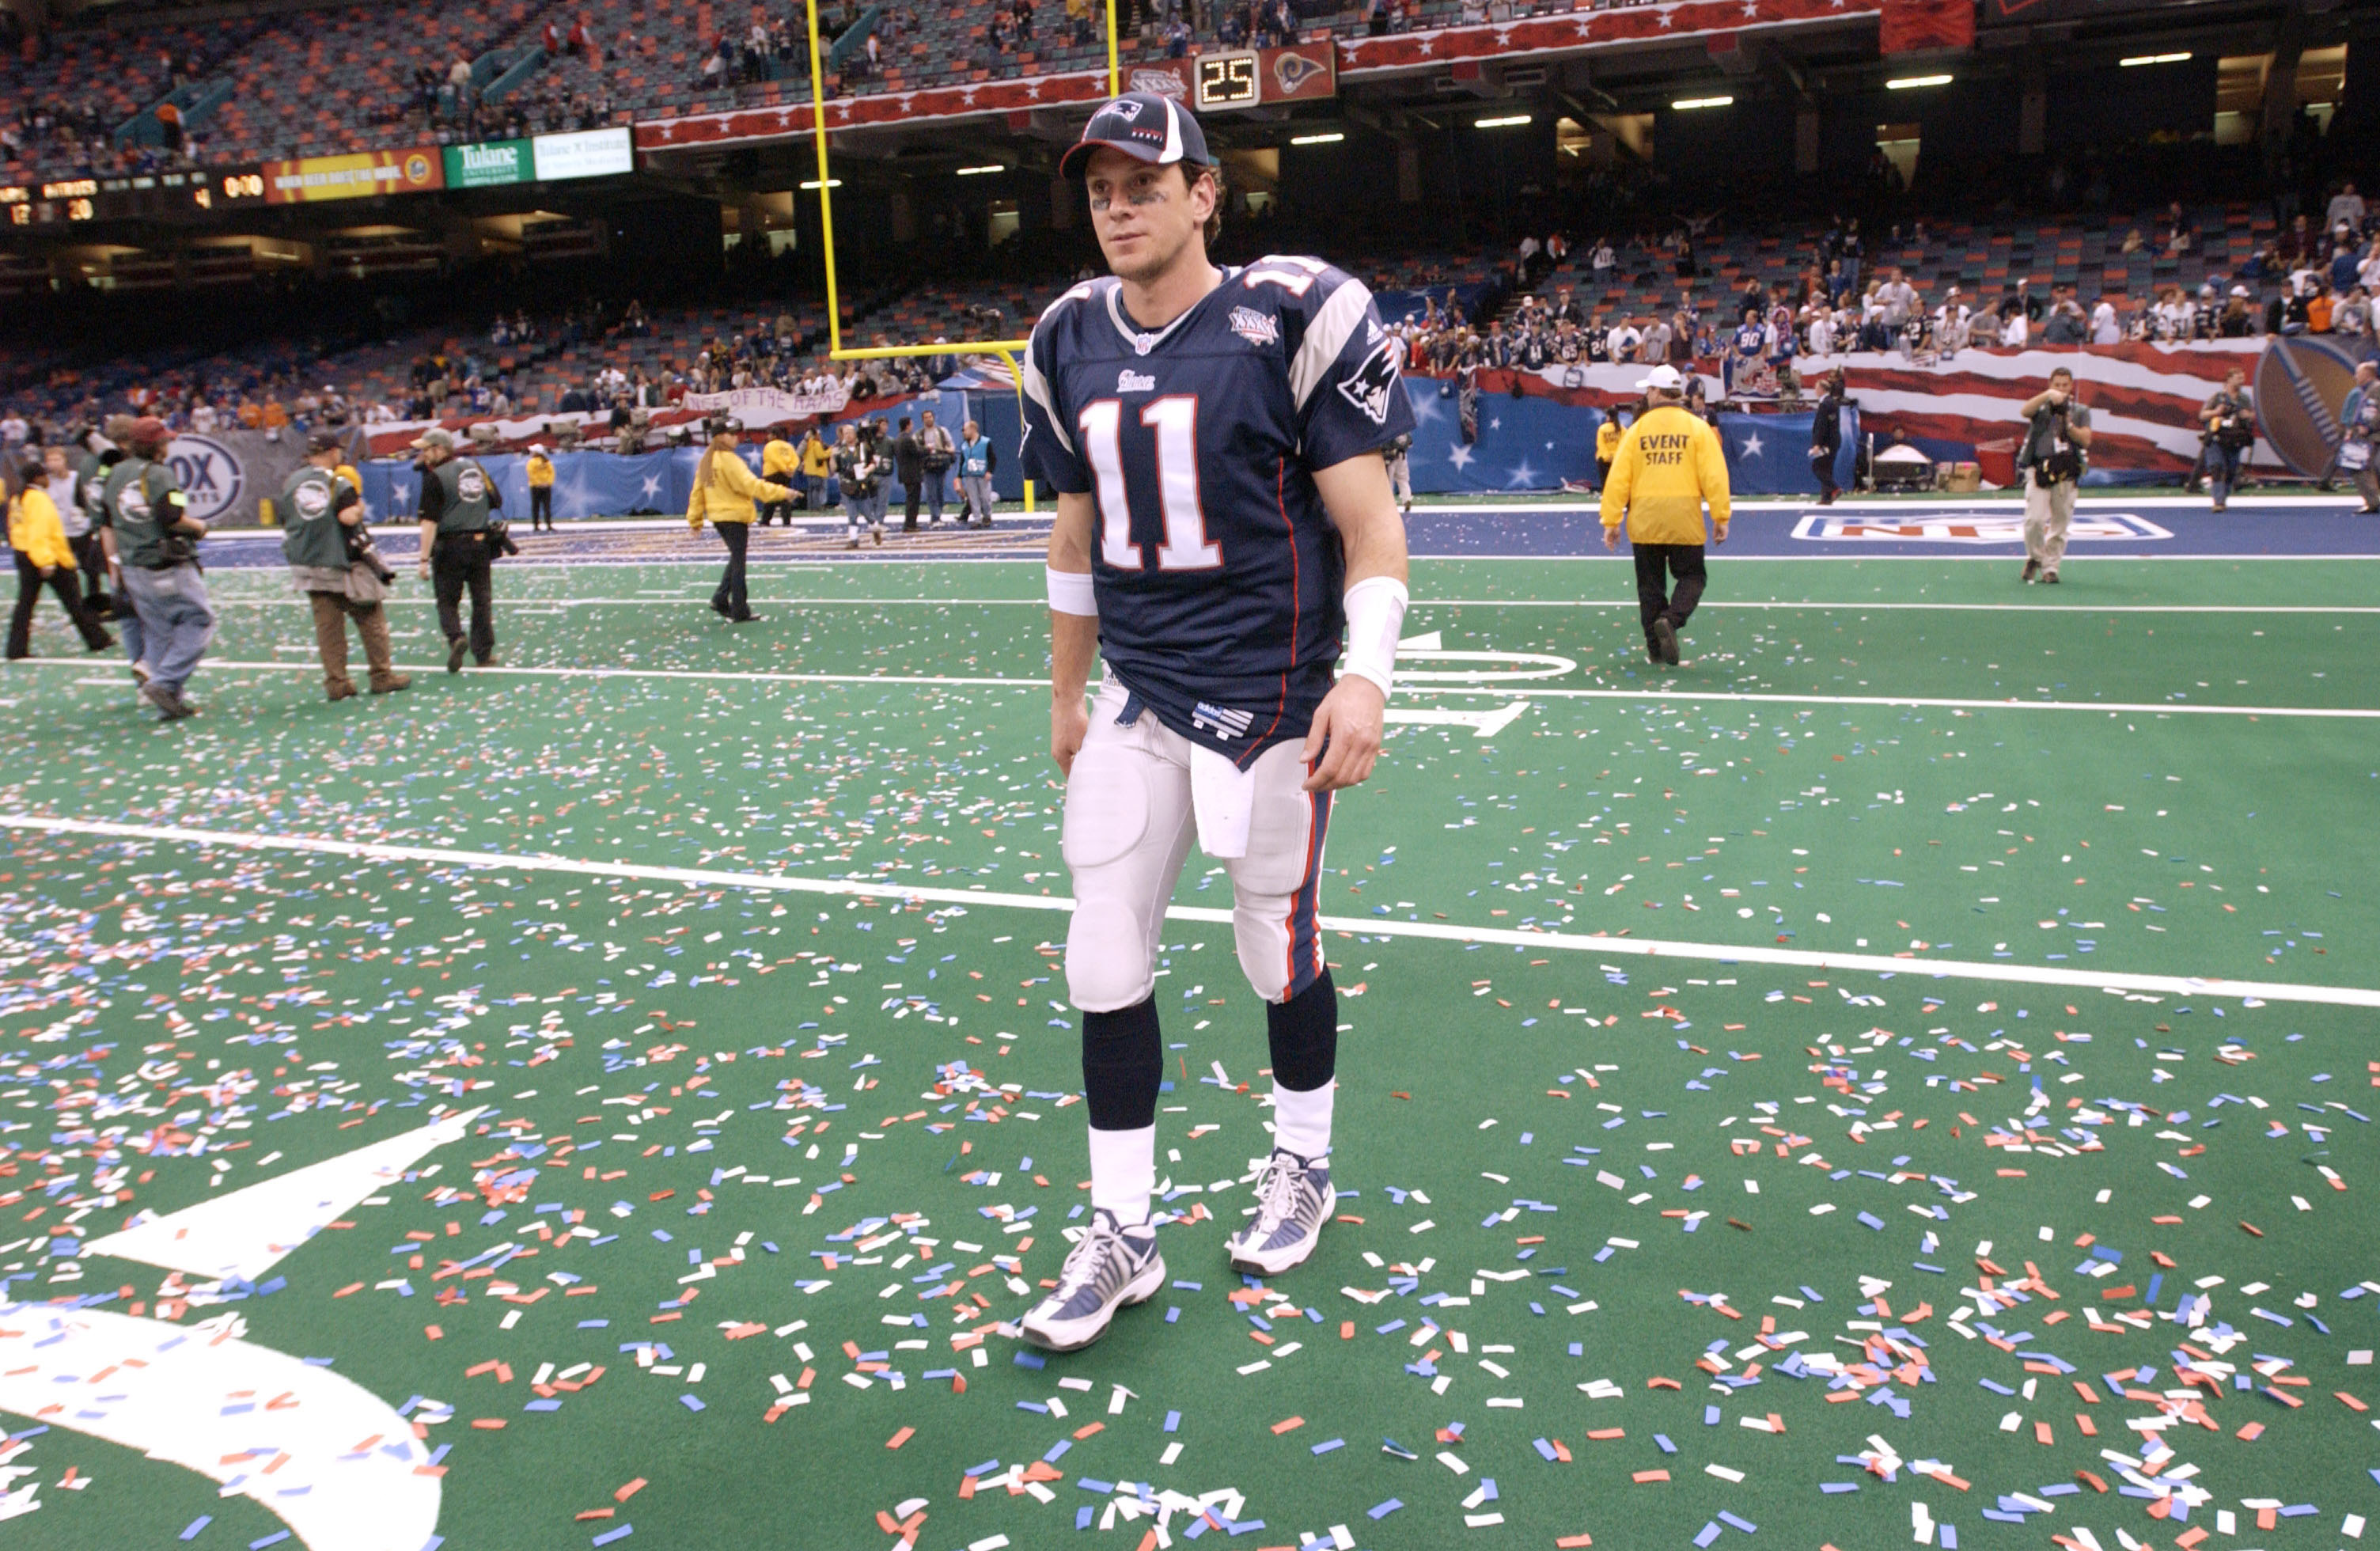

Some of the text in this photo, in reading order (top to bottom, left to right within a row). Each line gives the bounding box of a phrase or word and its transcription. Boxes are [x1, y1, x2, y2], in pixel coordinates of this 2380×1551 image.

[1202, 57, 1253, 103] 25
[457, 143, 519, 169] Tulane
[757, 389, 785, 409] THE
[1639, 434, 1691, 451] EVENT
[169, 453, 218, 490] OX
[1645, 451, 1685, 466] STAFF
[1078, 393, 1225, 573] 11
